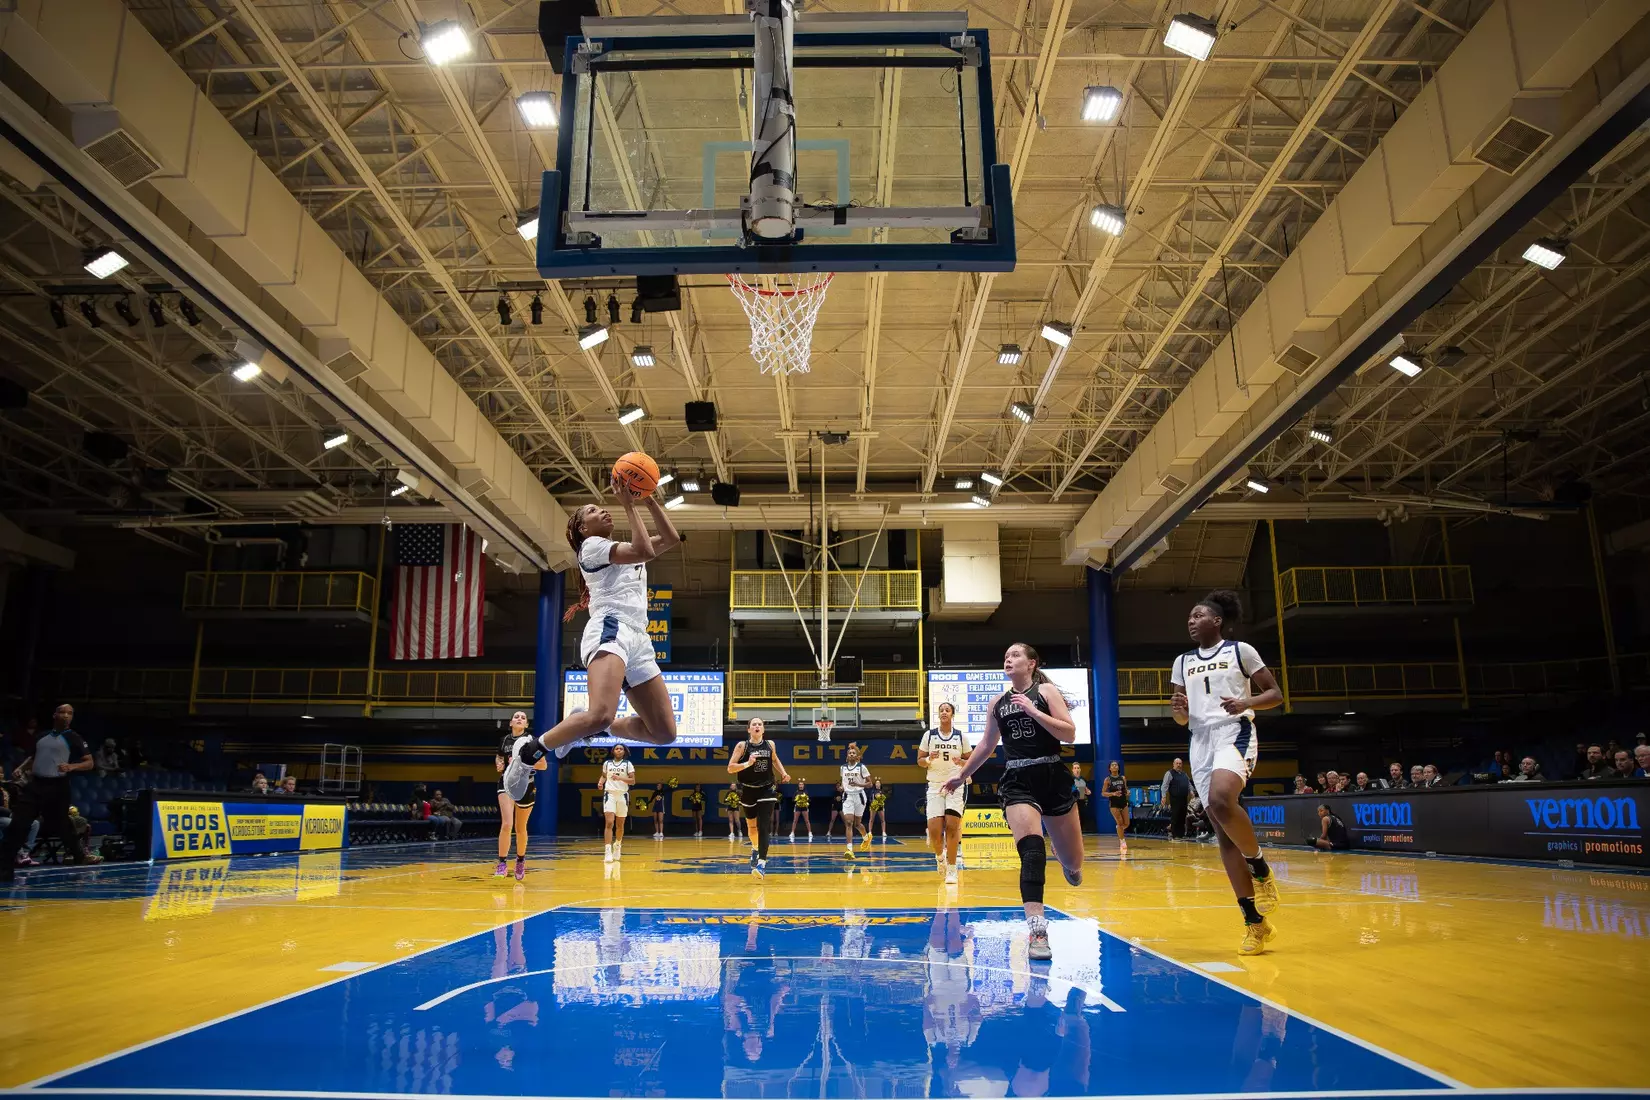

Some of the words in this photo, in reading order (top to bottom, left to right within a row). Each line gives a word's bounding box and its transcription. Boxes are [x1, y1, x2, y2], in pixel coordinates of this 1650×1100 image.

[646, 620, 668, 633] AA
[1188, 662, 1228, 676] ROOS
[1204, 676, 1211, 694] 1
[1007, 717, 1036, 740] 35
[685, 737, 714, 746] evergy
[643, 747, 729, 760] KANS
[943, 752, 949, 761] 5
[1248, 805, 1285, 824] vernon
[1352, 802, 1413, 826] vernon
[1525, 796, 1641, 830] vernon
[167, 814, 219, 831] ROOS
[173, 832, 226, 851] GEAR
[1363, 834, 1380, 842] graphics
[1384, 834, 1413, 844] promotions
[1547, 840, 1578, 852] graphics
[1585, 841, 1643, 854] promotions
